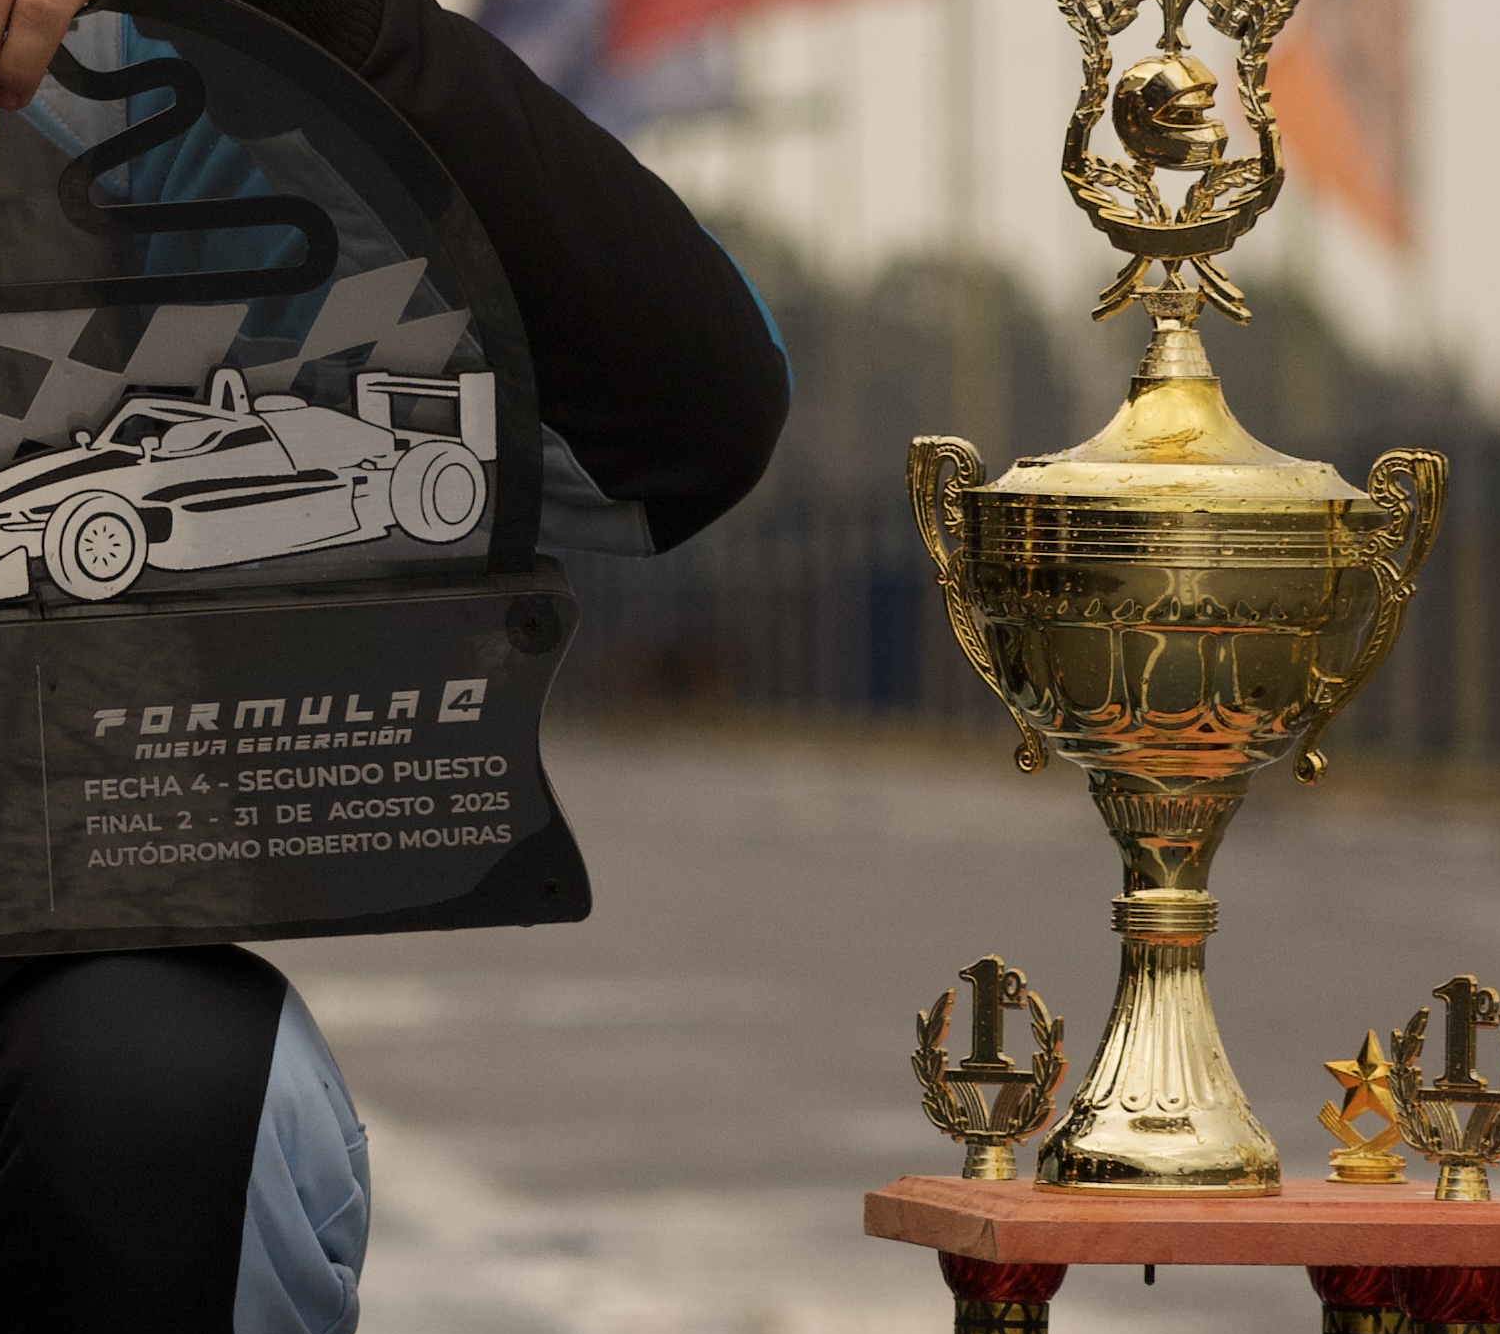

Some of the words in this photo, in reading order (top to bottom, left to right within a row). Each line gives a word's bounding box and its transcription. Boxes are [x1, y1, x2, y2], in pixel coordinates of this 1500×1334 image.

[93, 690, 420, 737] FORMULA
[438, 678, 488, 723] 4
[134, 740, 227, 760] NUEVA
[84, 775, 183, 801] FECHA
[190, 773, 211, 794] 4
[237, 762, 384, 793] SEGUNDO
[393, 755, 508, 783] PUESTO
[86, 812, 162, 835] FINAL
[178, 810, 193, 831] 2
[234, 806, 259, 826] 31
[276, 803, 312, 824] DE
[328, 795, 435, 821] AGOSTO
[450, 791, 510, 814] 2025
[87, 838, 261, 868] AUTÓDROMO
[268, 830, 393, 858] ROBERTO
[400, 824, 512, 850] MOURAS
